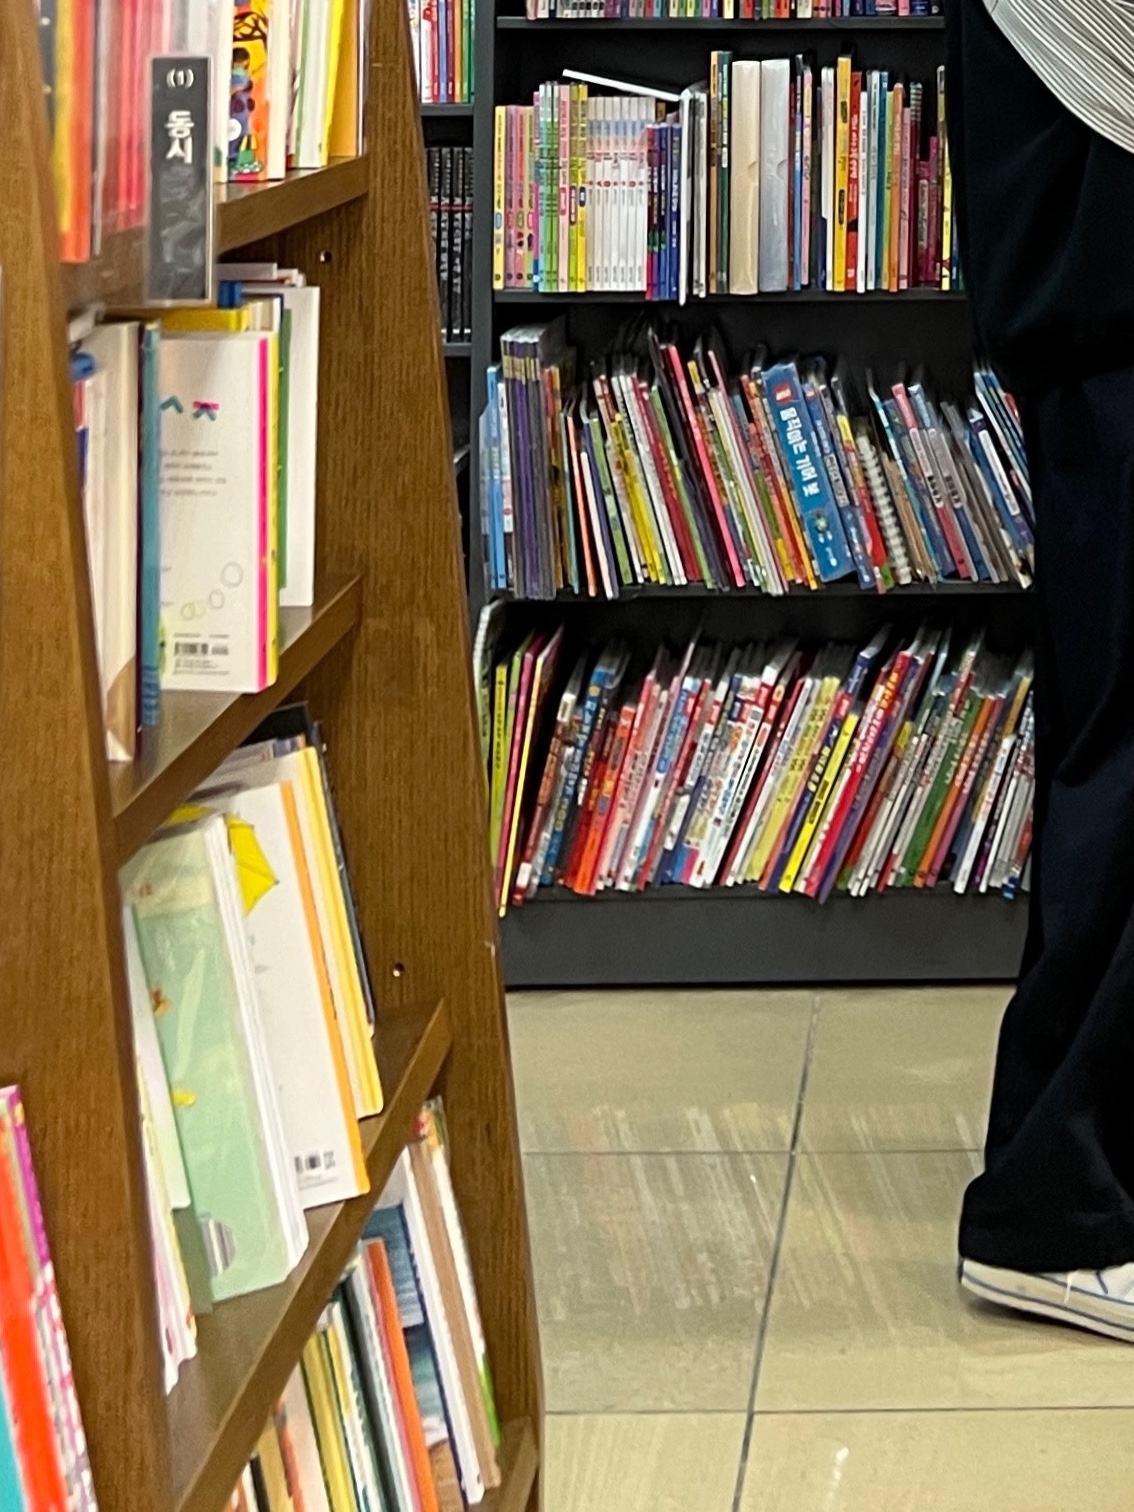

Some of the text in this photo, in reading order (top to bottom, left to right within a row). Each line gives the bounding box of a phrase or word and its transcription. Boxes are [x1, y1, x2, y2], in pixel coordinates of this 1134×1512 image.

[166, 68, 195, 89] (1)
[164, 110, 195, 164] 동시
[780, 407, 807, 455] 움직이는
